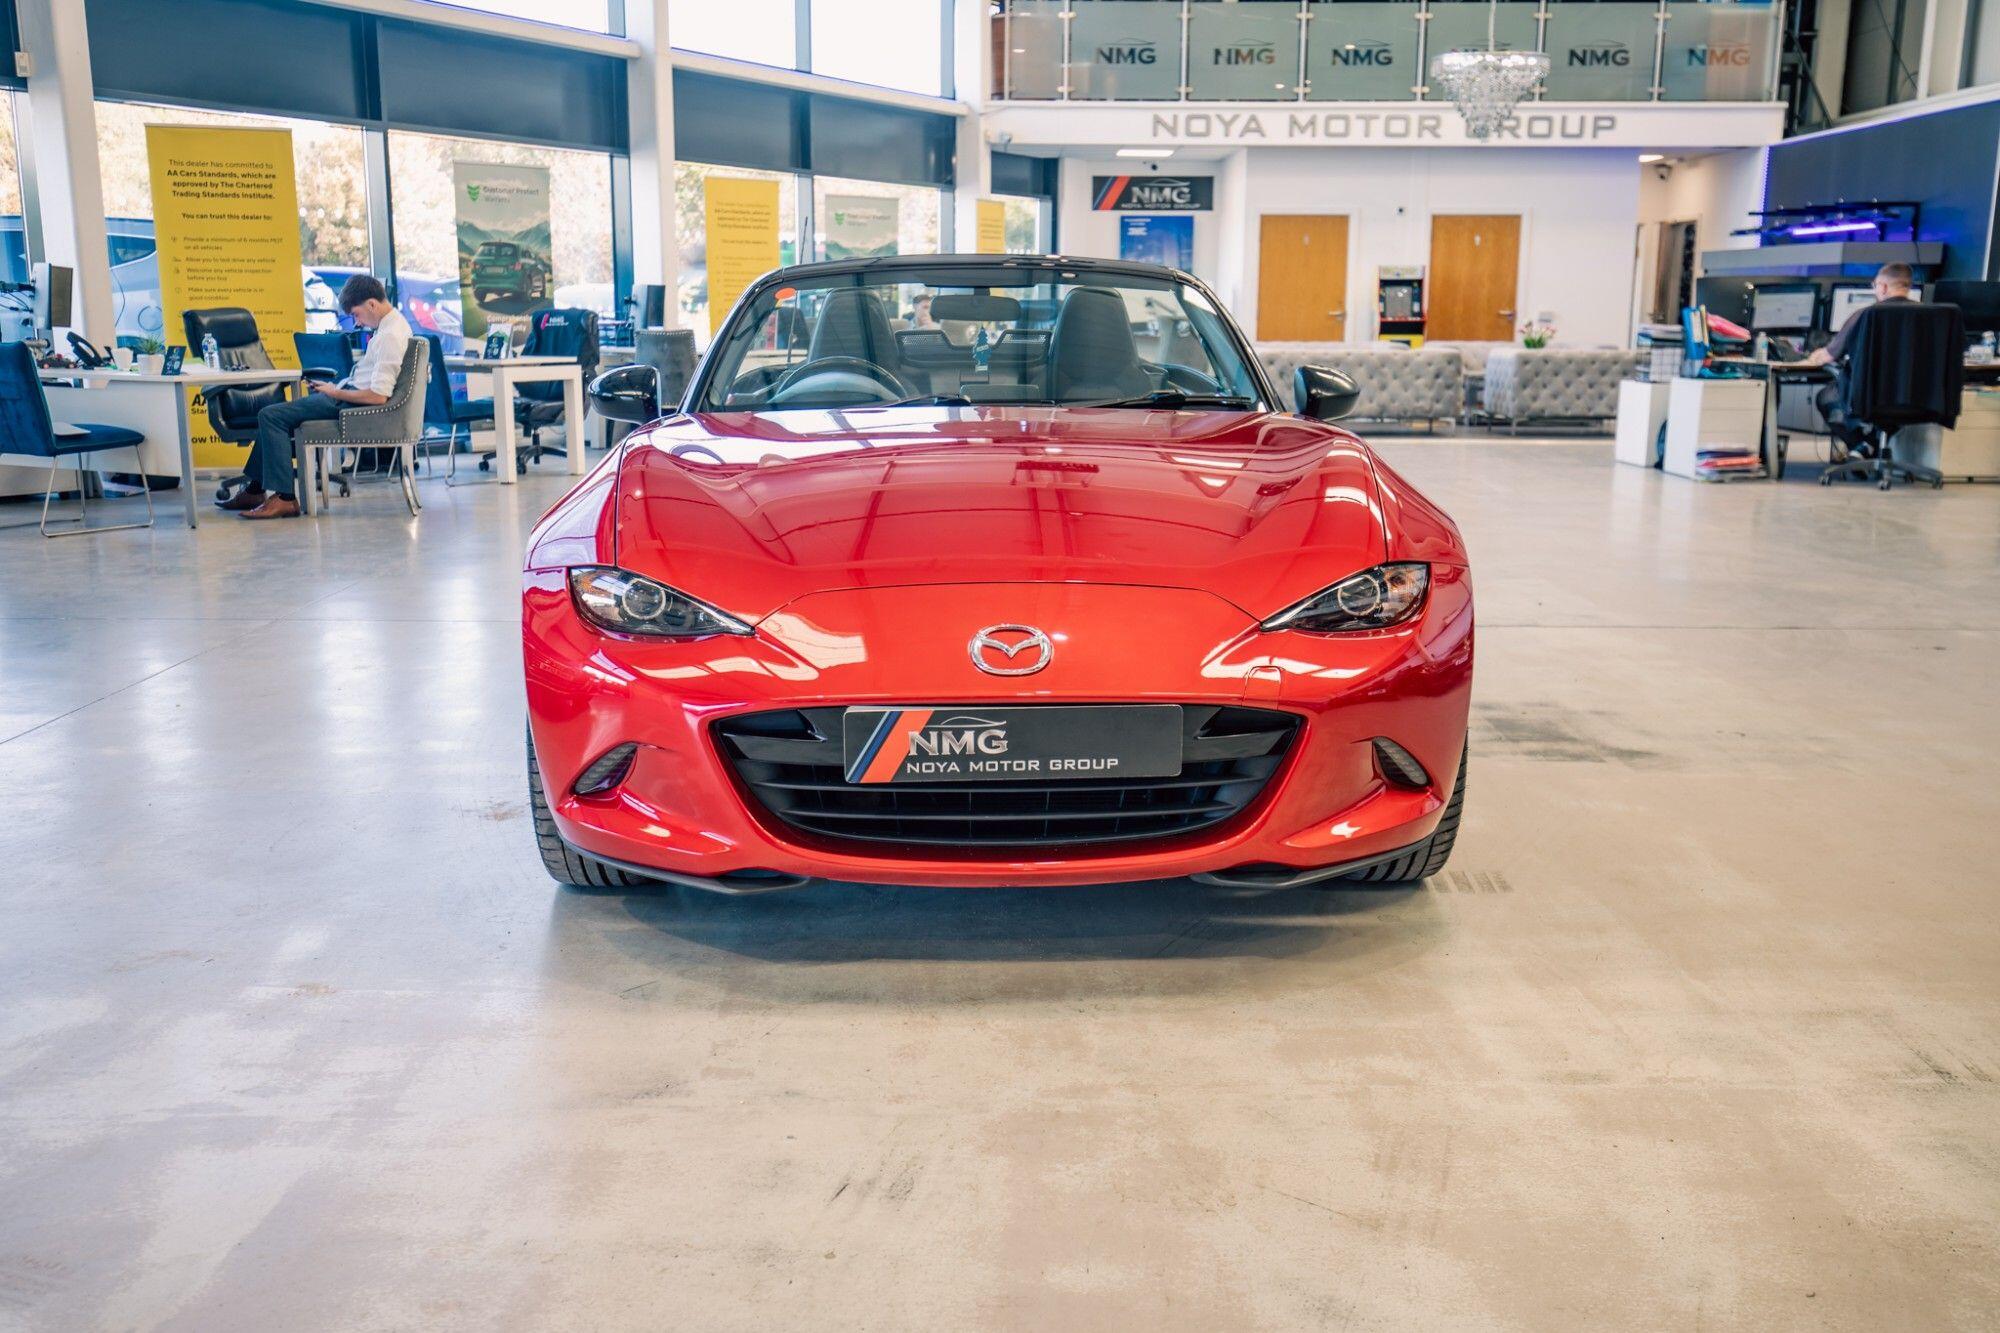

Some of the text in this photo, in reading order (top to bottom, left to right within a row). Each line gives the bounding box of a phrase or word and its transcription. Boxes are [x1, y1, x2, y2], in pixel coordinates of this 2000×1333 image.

[1097, 48, 1156, 64] NMG
[1214, 48, 1275, 65] NMG
[1332, 48, 1392, 66] NMG
[1569, 48, 1629, 66] NMG
[1688, 48, 1749, 66] NMG
[1152, 114, 1266, 137] NOYA
[1289, 114, 1441, 138] MOTOR
[169, 159, 184, 167] This
[186, 160, 208, 168] dealer
[210, 160, 223, 168] has
[225, 161, 264, 169] committed
[198, 171, 240, 179] Standards,
[240, 171, 263, 179] which
[210, 181, 219, 189] by
[172, 190, 200, 199] Trading
[202, 191, 240, 199] Standards
[1131, 186, 1191, 203] NMG
[191, 436, 207, 444] ow
[908, 729, 1008, 756] NMG
[907, 758, 1119, 773] NOYA MOTOR GROUP
